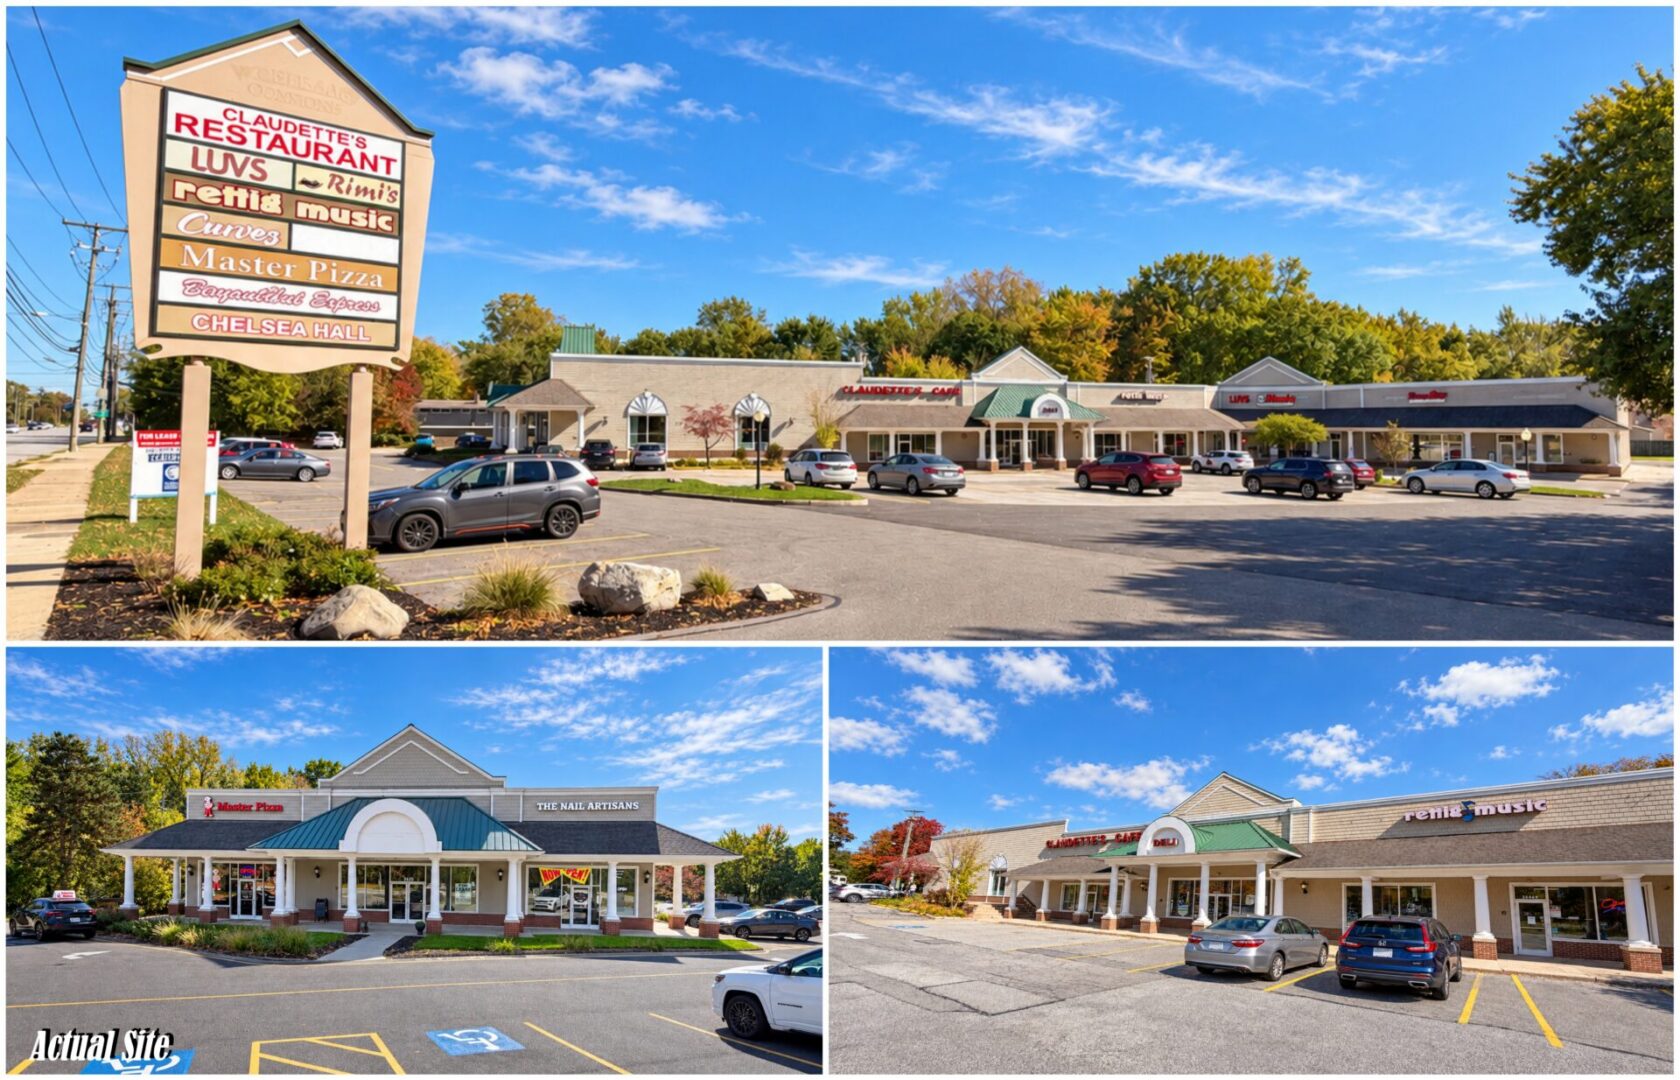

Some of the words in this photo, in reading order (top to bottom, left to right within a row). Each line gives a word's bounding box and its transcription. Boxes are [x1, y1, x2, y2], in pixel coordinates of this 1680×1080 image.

[222, 107, 368, 150] CLAUDETTE'S
[174, 112, 398, 176] RESTAURANT
[190, 146, 268, 182] LUVS
[326, 172, 399, 205] Rimi's
[172, 178, 284, 216] rettig
[294, 200, 394, 233] music
[176, 211, 281, 246] Curves
[180, 243, 297, 280] Master
[307, 258, 384, 289] Pizza
[309, 290, 381, 313] Express
[191, 313, 308, 338] CHELSEA
[312, 323, 372, 342] HALL
[217, 802, 252, 812] Master
[255, 802, 284, 812] Pizza
[536, 802, 558, 811] THE
[560, 802, 585, 811] NAIL
[587, 801, 640, 811] ARTISANS
[1473, 799, 1548, 817] music
[1046, 834, 1107, 849] CLAUDETTE'S
[1153, 838, 1178, 848] DELI
[540, 867, 561, 883] NOW
